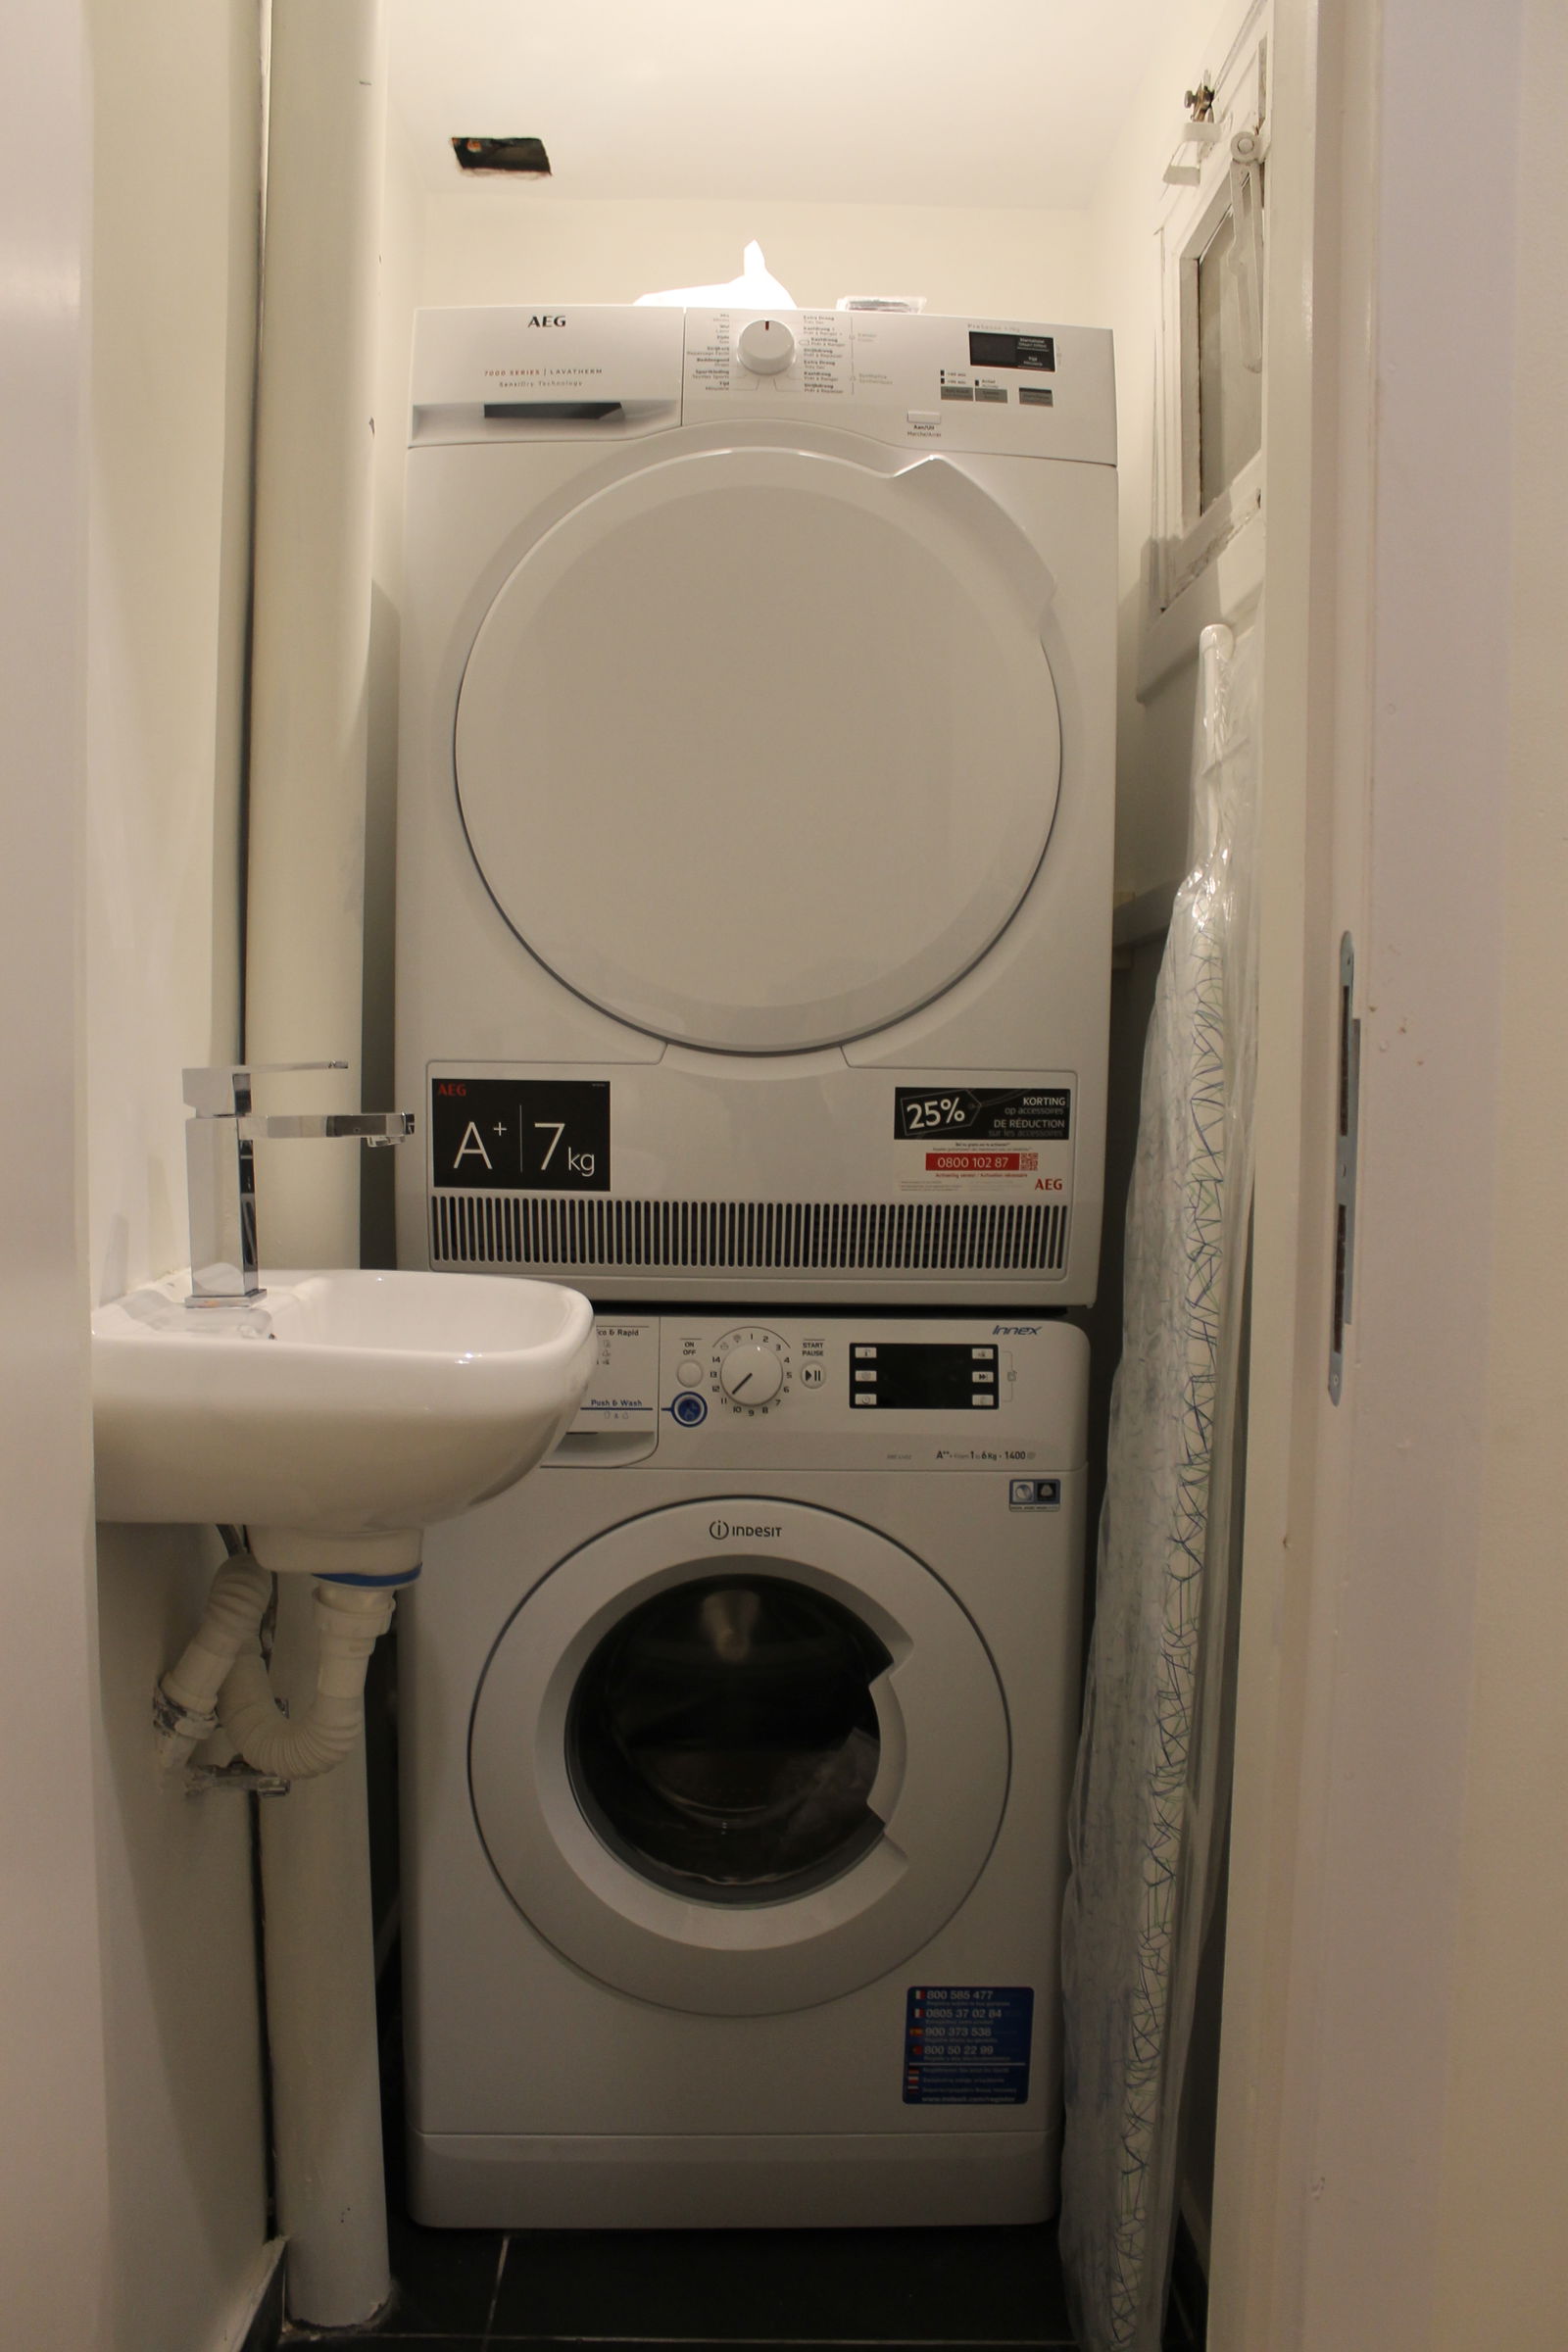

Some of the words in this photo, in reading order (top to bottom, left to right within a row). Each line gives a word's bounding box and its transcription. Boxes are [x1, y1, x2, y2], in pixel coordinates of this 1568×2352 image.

[527, 316, 566, 328] AEG
[438, 1082, 466, 1097] AEG
[1023, 1097, 1066, 1106] KORTING
[906, 1096, 965, 1130] 25%
[994, 1119, 1007, 1128] DE
[1008, 1117, 1065, 1129] RÉDUCTION
[534, 1122, 565, 1171] 7
[567, 1147, 596, 1177] kg
[937, 1156, 969, 1169] 0800
[972, 1156, 992, 1169] 102
[995, 1156, 1009, 1169] 87
[1035, 1178, 1063, 1191] AEG
[617, 1329, 639, 1338] Rapid
[992, 1325, 1043, 1336] Innex
[1004, 1450, 1026, 1460] 1400
[926, 1990, 948, 2000] 800
[950, 1990, 970, 2000] 585
[972, 1990, 994, 2000] 477
[925, 2009, 953, 2018] 0805
[956, 2009, 969, 2018] 37
[971, 2009, 985, 2018] 02
[948, 2027, 968, 2036] 373
[963, 2045, 977, 2055] 22
